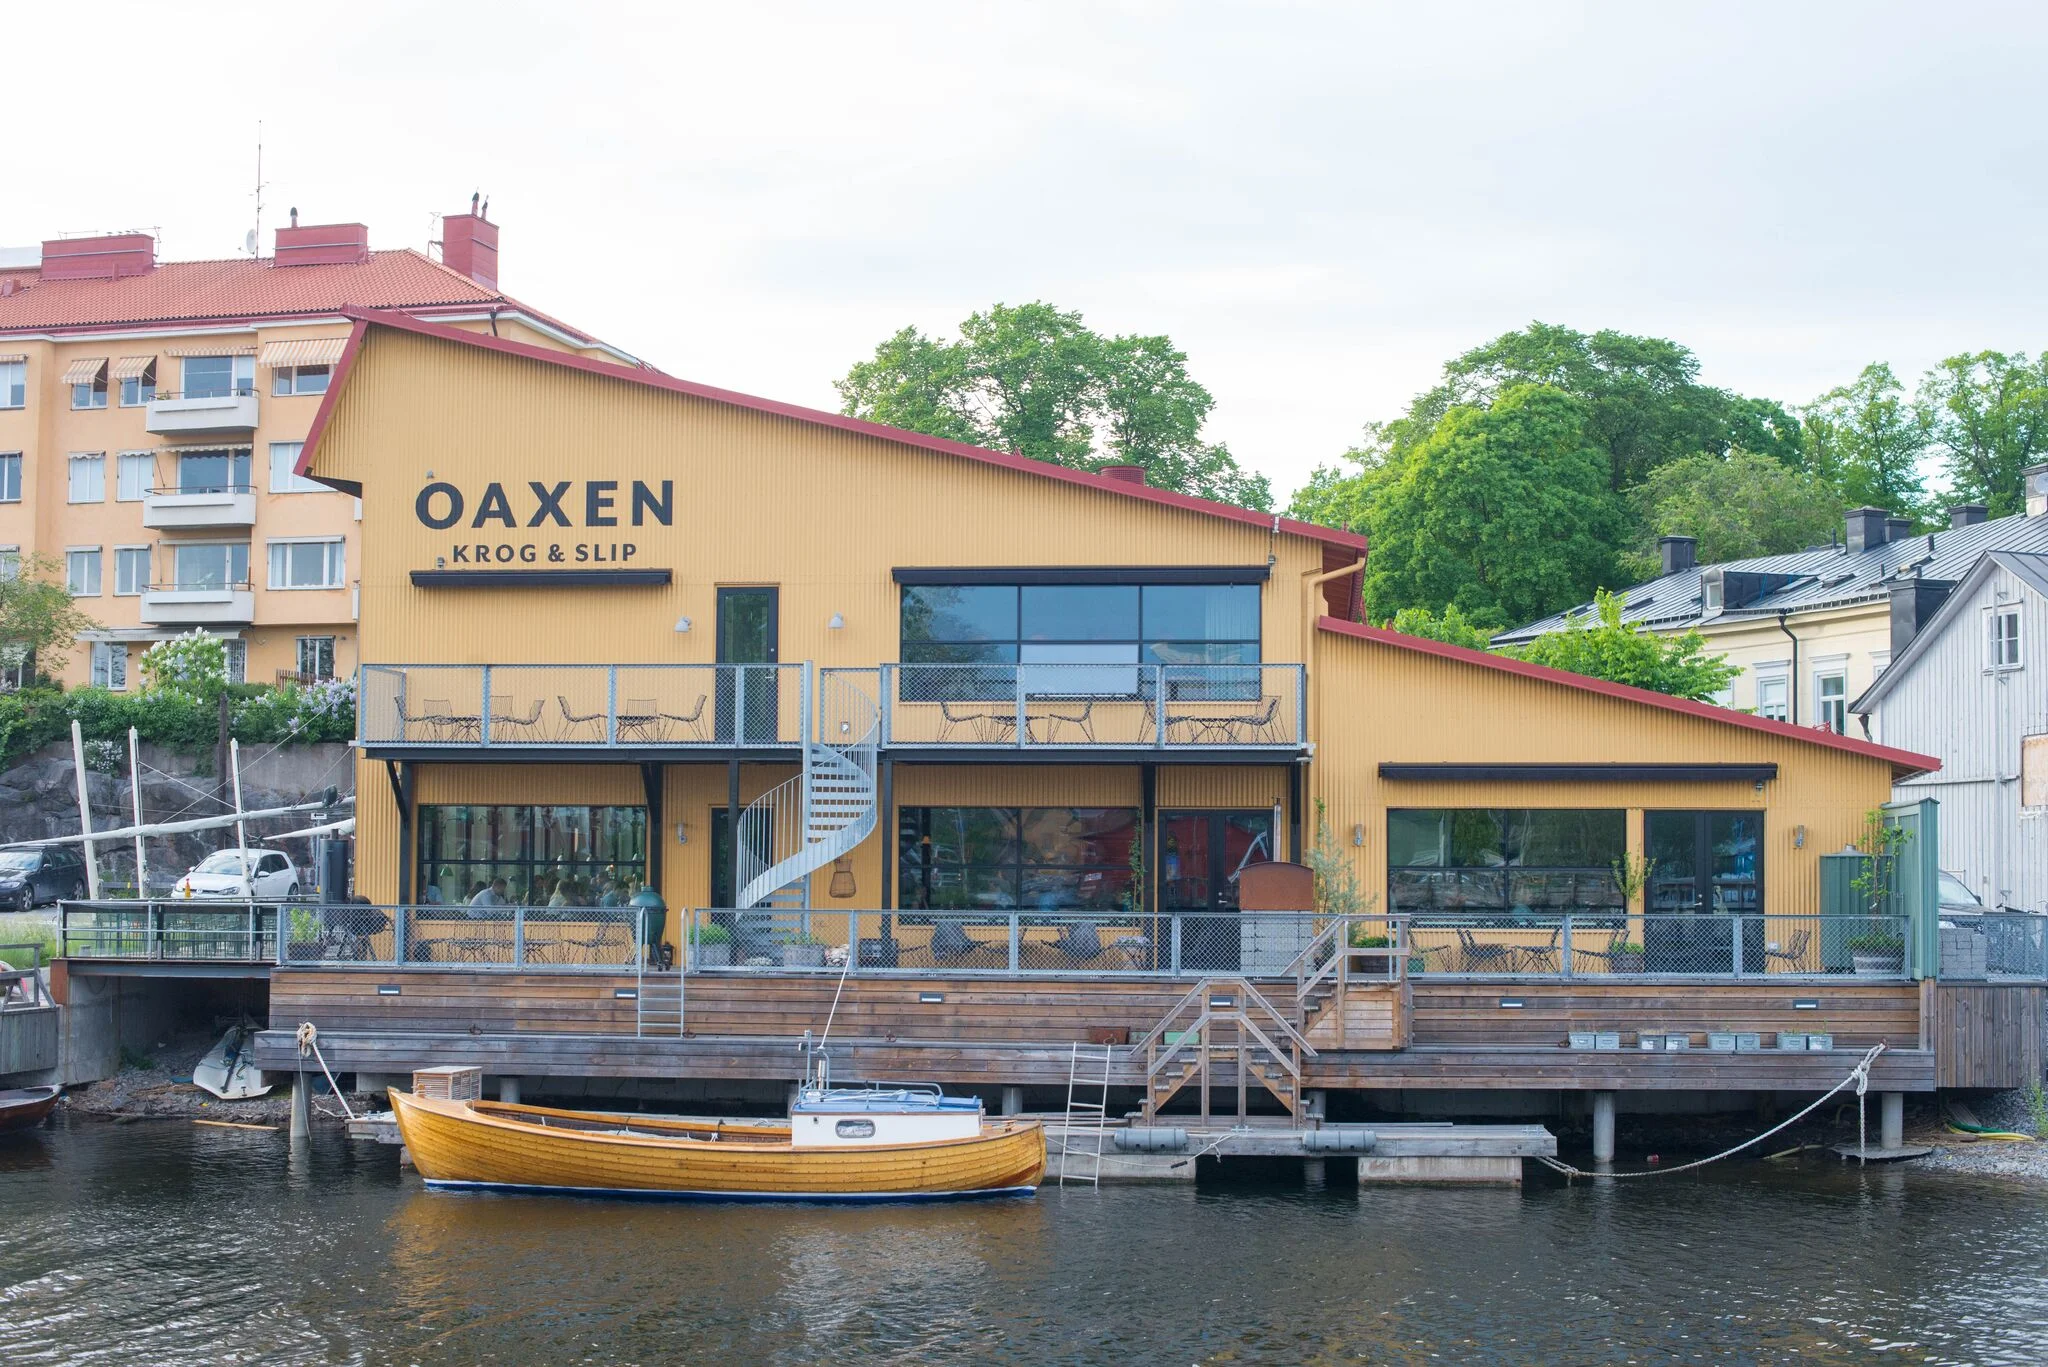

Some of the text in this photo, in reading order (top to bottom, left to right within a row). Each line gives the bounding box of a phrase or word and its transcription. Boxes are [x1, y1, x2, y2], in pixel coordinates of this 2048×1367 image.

[415, 480, 674, 530] OAXEN
[453, 543, 637, 563] KROG & SLIP
